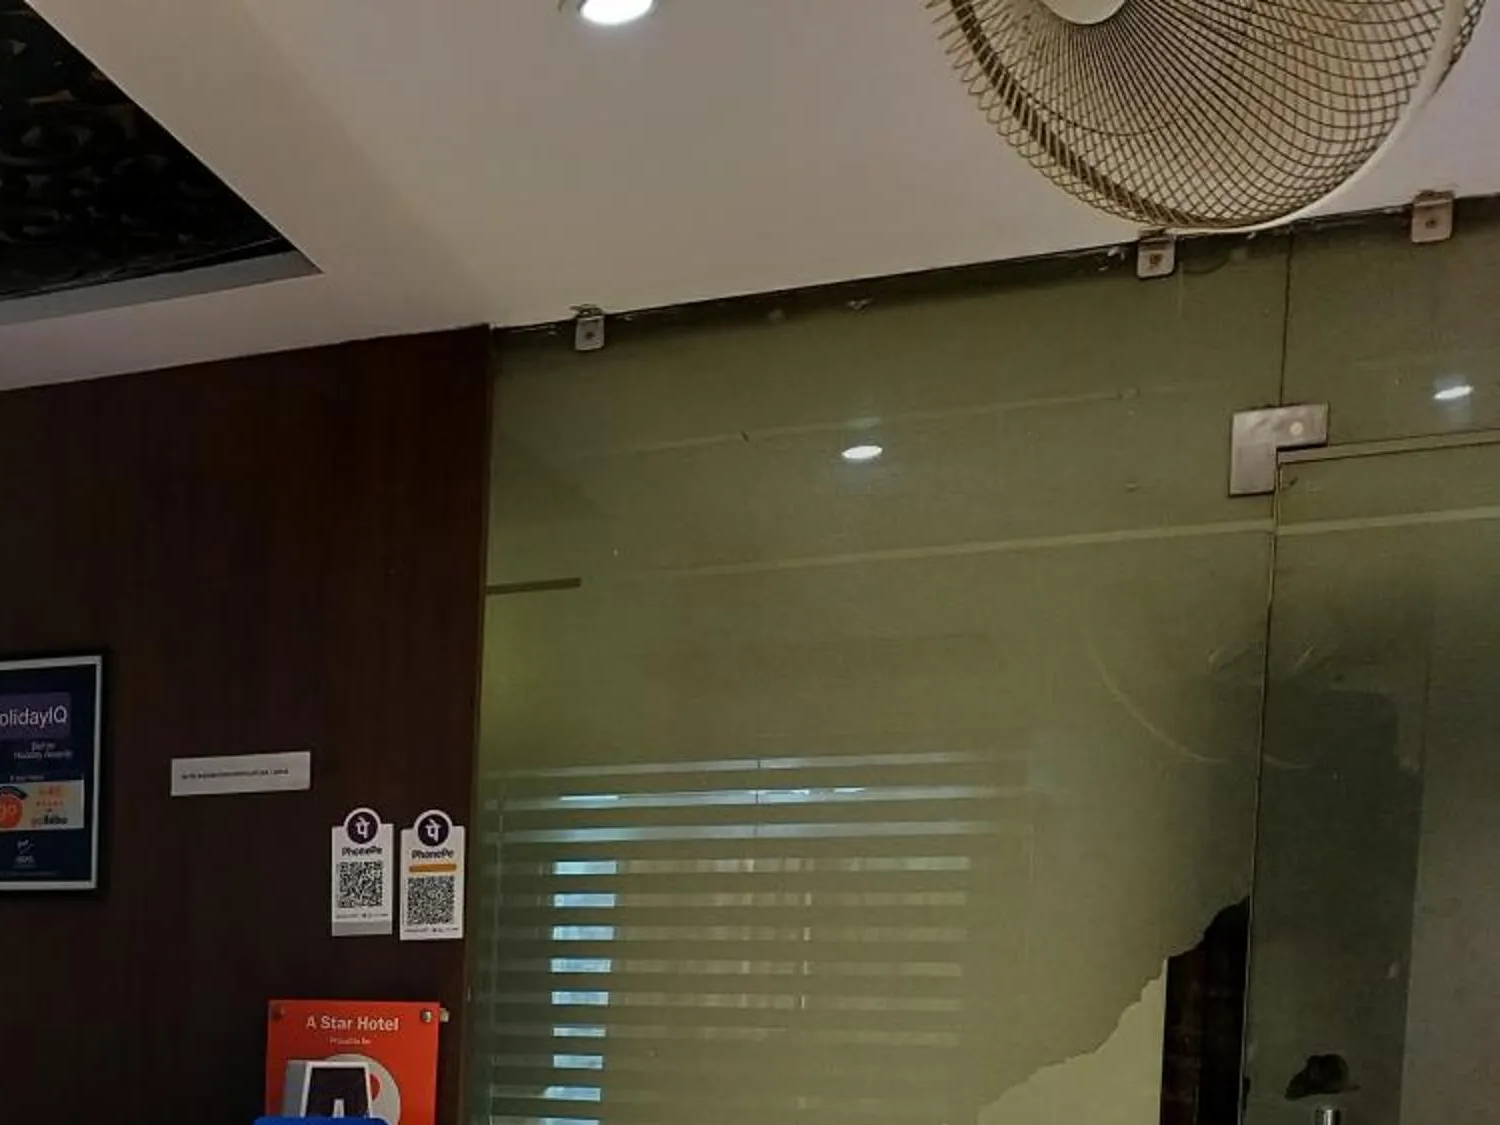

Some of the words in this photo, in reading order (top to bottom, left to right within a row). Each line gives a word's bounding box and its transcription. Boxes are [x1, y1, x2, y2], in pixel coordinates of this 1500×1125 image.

[342, 846, 382, 857] PhonePe
[411, 848, 455, 859] PhonePe
[305, 1016, 317, 1029] A
[320, 1015, 353, 1030] Star
[357, 1016, 399, 1031] Hotel
